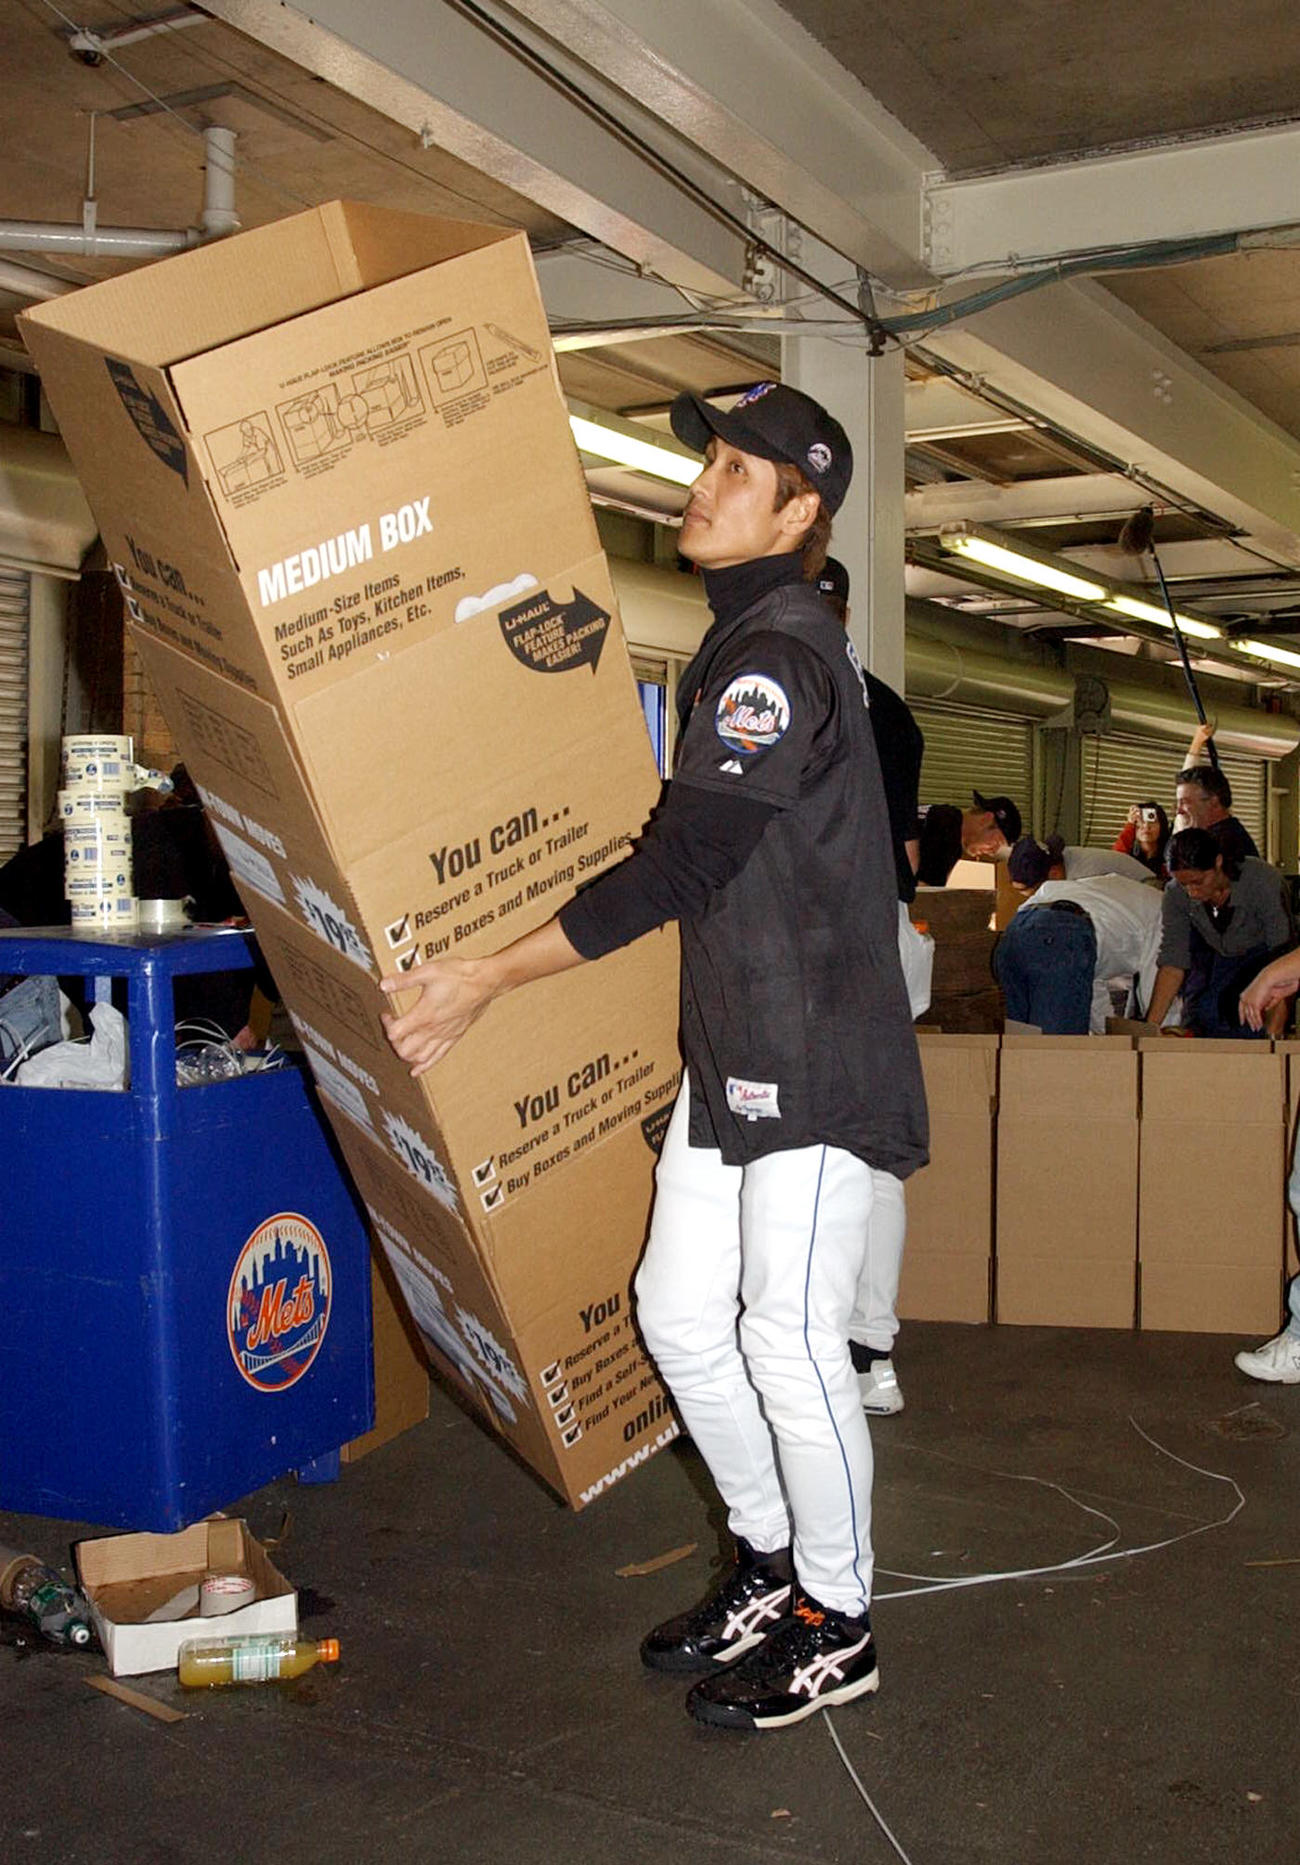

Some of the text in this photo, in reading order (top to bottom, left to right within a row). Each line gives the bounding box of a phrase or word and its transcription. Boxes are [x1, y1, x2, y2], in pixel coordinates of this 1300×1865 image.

[125, 533, 158, 579] You
[257, 496, 433, 607] MEDIUM BOX
[274, 573, 400, 642] Medium-Size Items
[280, 566, 466, 662] Such As Toys, Kitchen Items,
[287, 603, 432, 680] Small Appliances, Etc.
[524, 626, 565, 655] FEATURE
[532, 618, 605, 663] MAKES PACKING
[545, 642, 582, 667] EASIER!
[723, 704, 777, 733] Mets
[415, 821, 589, 930] Reserve a Truck or Trailer
[428, 806, 570, 885] You can...
[424, 935, 450, 960] Buy
[453, 909, 495, 943] Boxes
[498, 891, 523, 917] and
[526, 865, 575, 901] Moving
[498, 1061, 655, 1169] Reserve a Truck or Trailer
[514, 1049, 639, 1129] You can...
[507, 1173, 531, 1194] Buy
[533, 1147, 571, 1178] Boxes
[573, 1127, 596, 1151] and
[599, 1101, 642, 1136] Moving
[644, 1072, 680, 1105] Suppli
[246, 1274, 316, 1350] Mets
[578, 1293, 621, 1335] You
[565, 1324, 621, 1370] Reserve a
[572, 1345, 629, 1391] Buy Boxes
[578, 1387, 603, 1411] Find
[606, 1379, 613, 1391] a
[585, 1389, 637, 1432] Find Your
